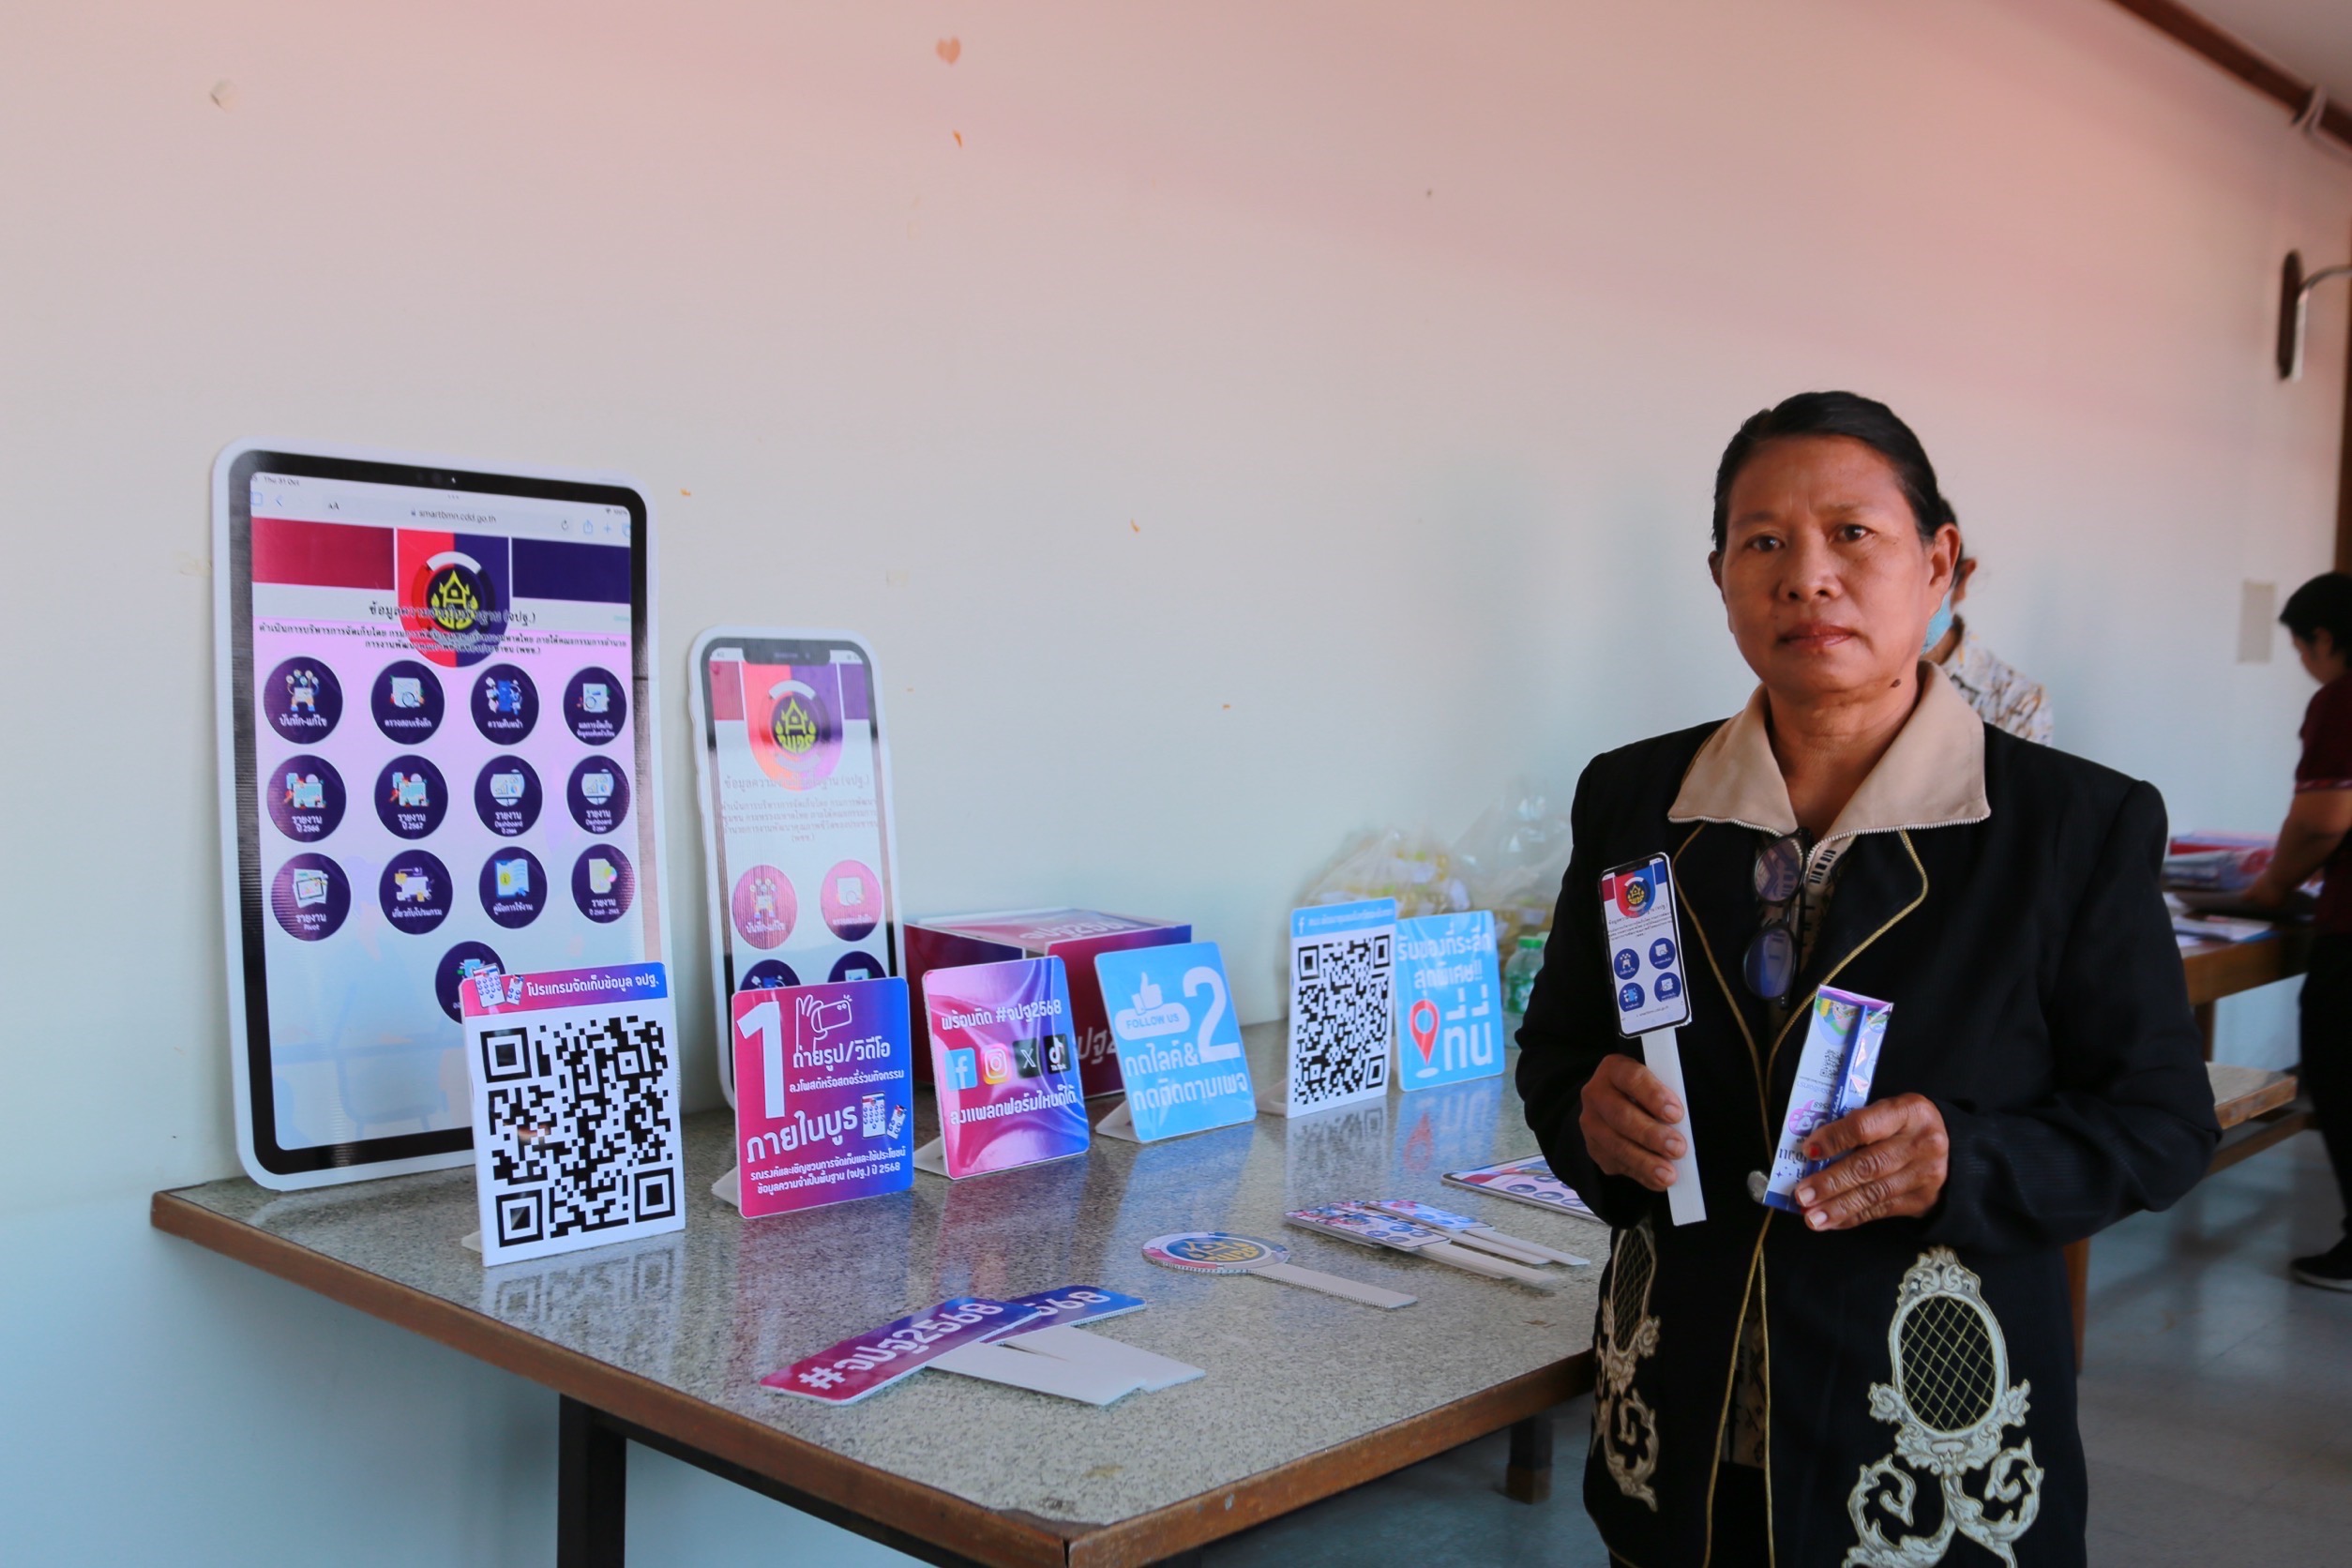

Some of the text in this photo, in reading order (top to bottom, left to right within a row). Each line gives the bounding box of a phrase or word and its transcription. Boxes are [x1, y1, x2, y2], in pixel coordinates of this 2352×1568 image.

[1397, 920, 1494, 961] รับของที่ระลึก
[526, 973, 659, 997] โปรแกรมจัดเก็บข้อมูล จปฐ.
[941, 999, 1063, 1031] พร้อมติด #จปฐ2568
[1125, 1013, 1181, 1030] FOLLOW US
[1183, 966, 1241, 1063] 2
[1442, 984, 1493, 1071] ที่นี่
[736, 1001, 786, 1119] 1
[792, 1035, 891, 1071] ถ่ายรูป/วิดีโอ
[949, 1084, 1078, 1125] ลงแพลตฟอร์มไหนก็ได้
[1132, 1071, 1248, 1111] กดติดตามเพจ
[746, 1105, 858, 1163] ภายในบูธ
[757, 1162, 901, 1197] ข้อมูลความจำเป็นพื้นฐาน (จปฐ.) ปี 2568
[797, 1301, 1005, 1392] #จปฐ2568
